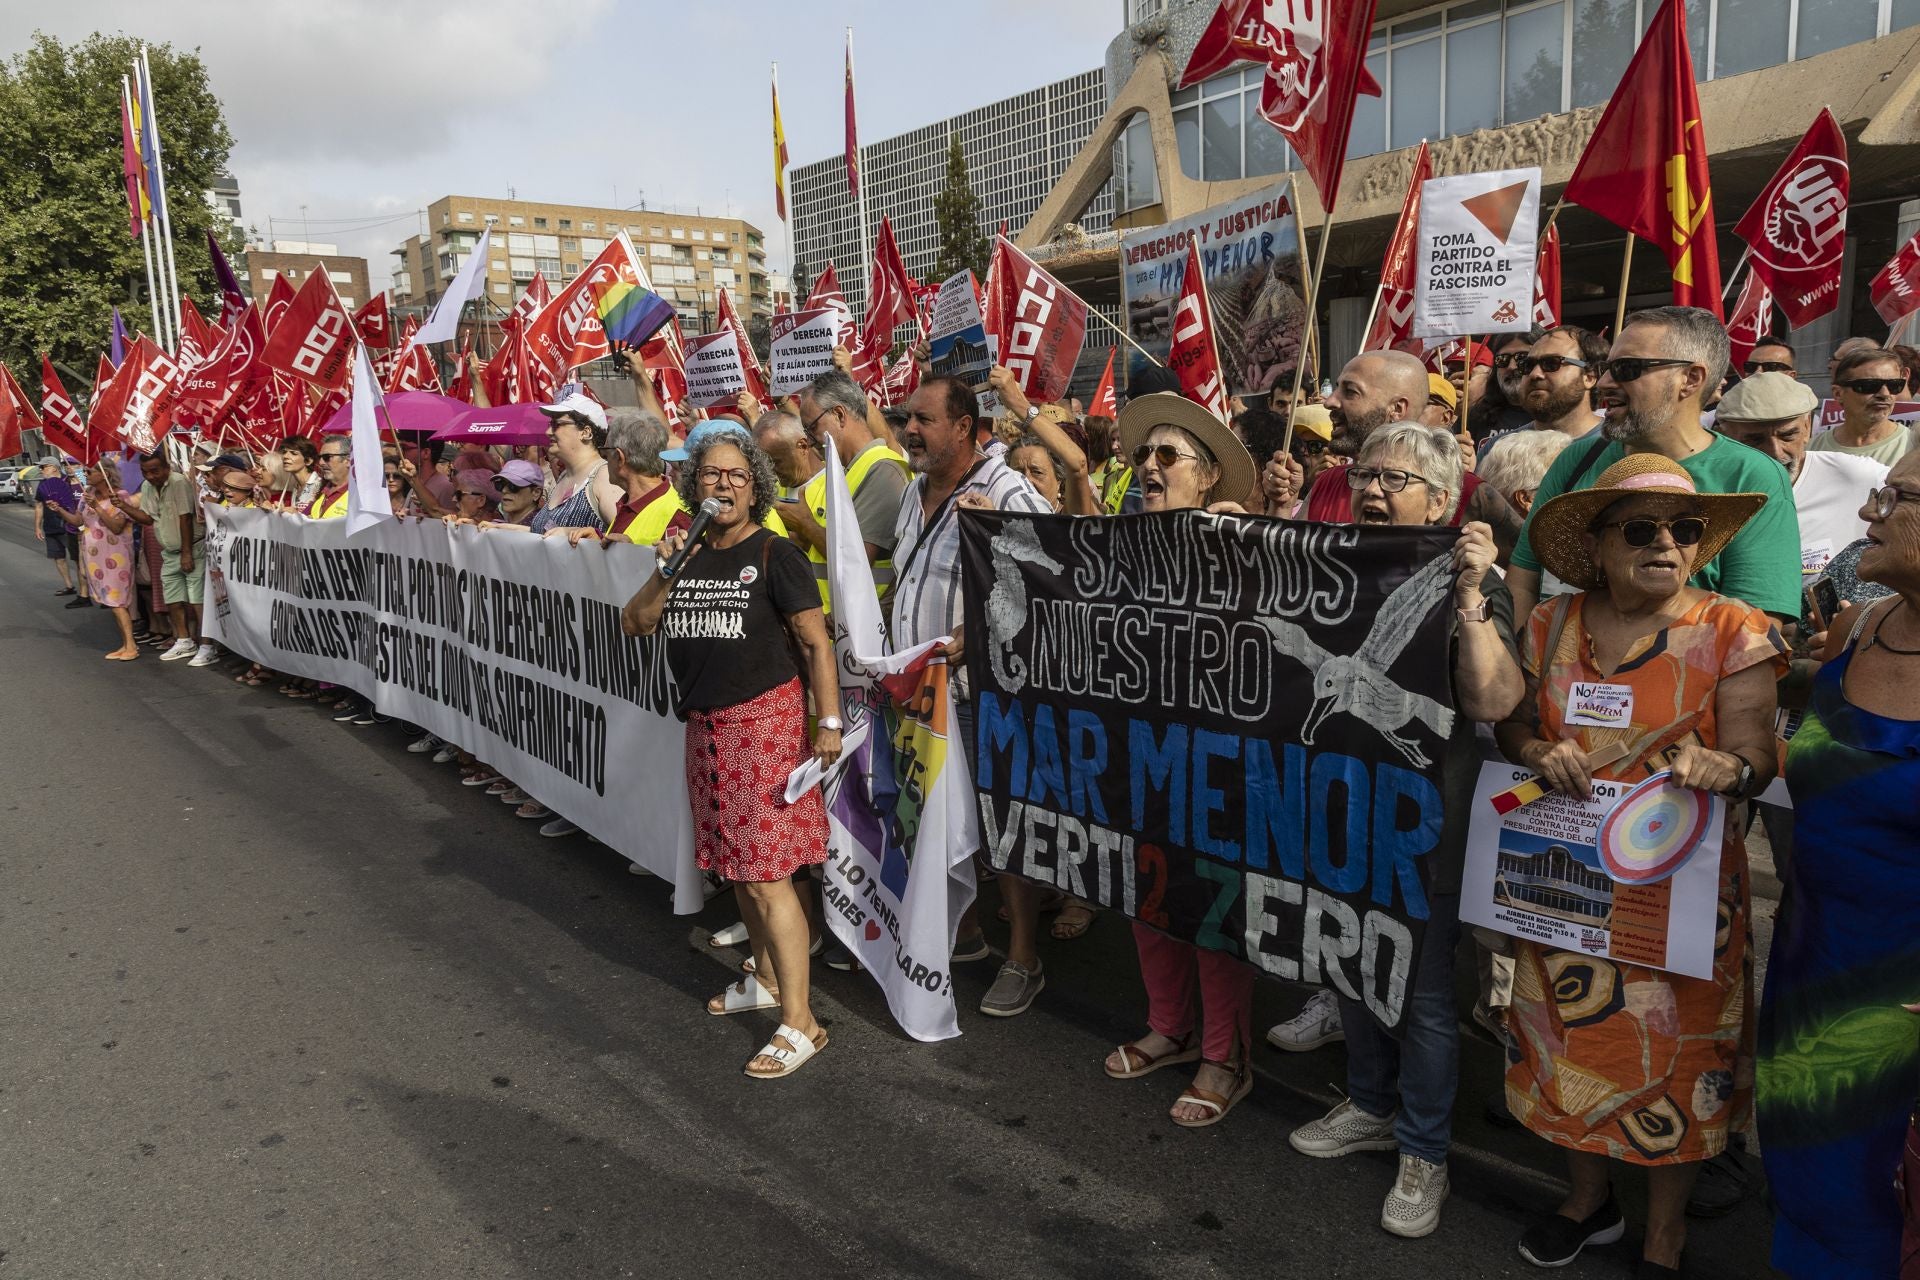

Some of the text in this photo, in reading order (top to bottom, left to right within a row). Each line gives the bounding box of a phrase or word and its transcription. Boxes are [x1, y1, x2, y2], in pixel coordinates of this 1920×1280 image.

[1783, 164, 1847, 247] UGT
[1126, 195, 1292, 266] DERECHOS Y JUSTICIA
[1432, 232, 1476, 248] TOMA
[1160, 258, 1185, 289] MA
[1204, 231, 1275, 279] MENOR
[1431, 245, 1496, 262] PARTIDO
[1430, 259, 1512, 276] CONTRA EL
[1429, 274, 1507, 291] FASCISMO
[793, 327, 833, 340] DERECHA
[697, 348, 735, 361] DERECHA
[776, 344, 832, 357] Y ULTRADERECHA
[690, 362, 738, 375] ULTRADERECHA
[777, 358, 833, 370] SE ALÍAN CONTRA
[712, 374, 741, 385] CONTRA
[790, 374, 804, 382] MÁS
[702, 388, 714, 397] MÁS
[467, 424, 505, 433] Sumar
[64, 430, 85, 449] Murc
[1070, 512, 1359, 625] SALVEMOS
[676, 579, 742, 590] MARCHAS
[675, 591, 690, 599] LA
[694, 590, 750, 600] DIGNIDAD
[229, 536, 250, 584] POR
[252, 538, 266, 587] LA
[408, 558, 436, 626] POR
[467, 573, 490, 652] LOS
[490, 578, 580, 682] DERECHOS
[718, 600, 749, 609] TECHO
[1031, 598, 1272, 721] NUESTRO
[270, 599, 319, 656] CONTRA
[308, 608, 349, 660] LOS
[415, 633, 439, 701] DEL
[470, 656, 500, 737] DEL
[494, 667, 606, 797] SUFRIMIENTO
[1576, 684, 1597, 698] No!
[977, 691, 1109, 826] MAR
[1129, 718, 1445, 921] MENOR
[1520, 808, 1531, 816] DE
[1532, 810, 1542, 818] LA
[1544, 812, 1597, 828] NATURALEZA
[1567, 809, 1605, 820] HUMANO
[1504, 819, 1565, 838] PRESUPUESTOS
[1566, 833, 1582, 842] DEL
[1529, 817, 1580, 833] CONTRA LOS
[836, 855, 866, 886] LO
[1506, 909, 1566, 929] ASAMBLEA REGIONAL
[1516, 925, 1553, 939] CARTAGENA
[1536, 924, 1553, 933] JULIO
[1195, 857, 1414, 1028] ZERO
